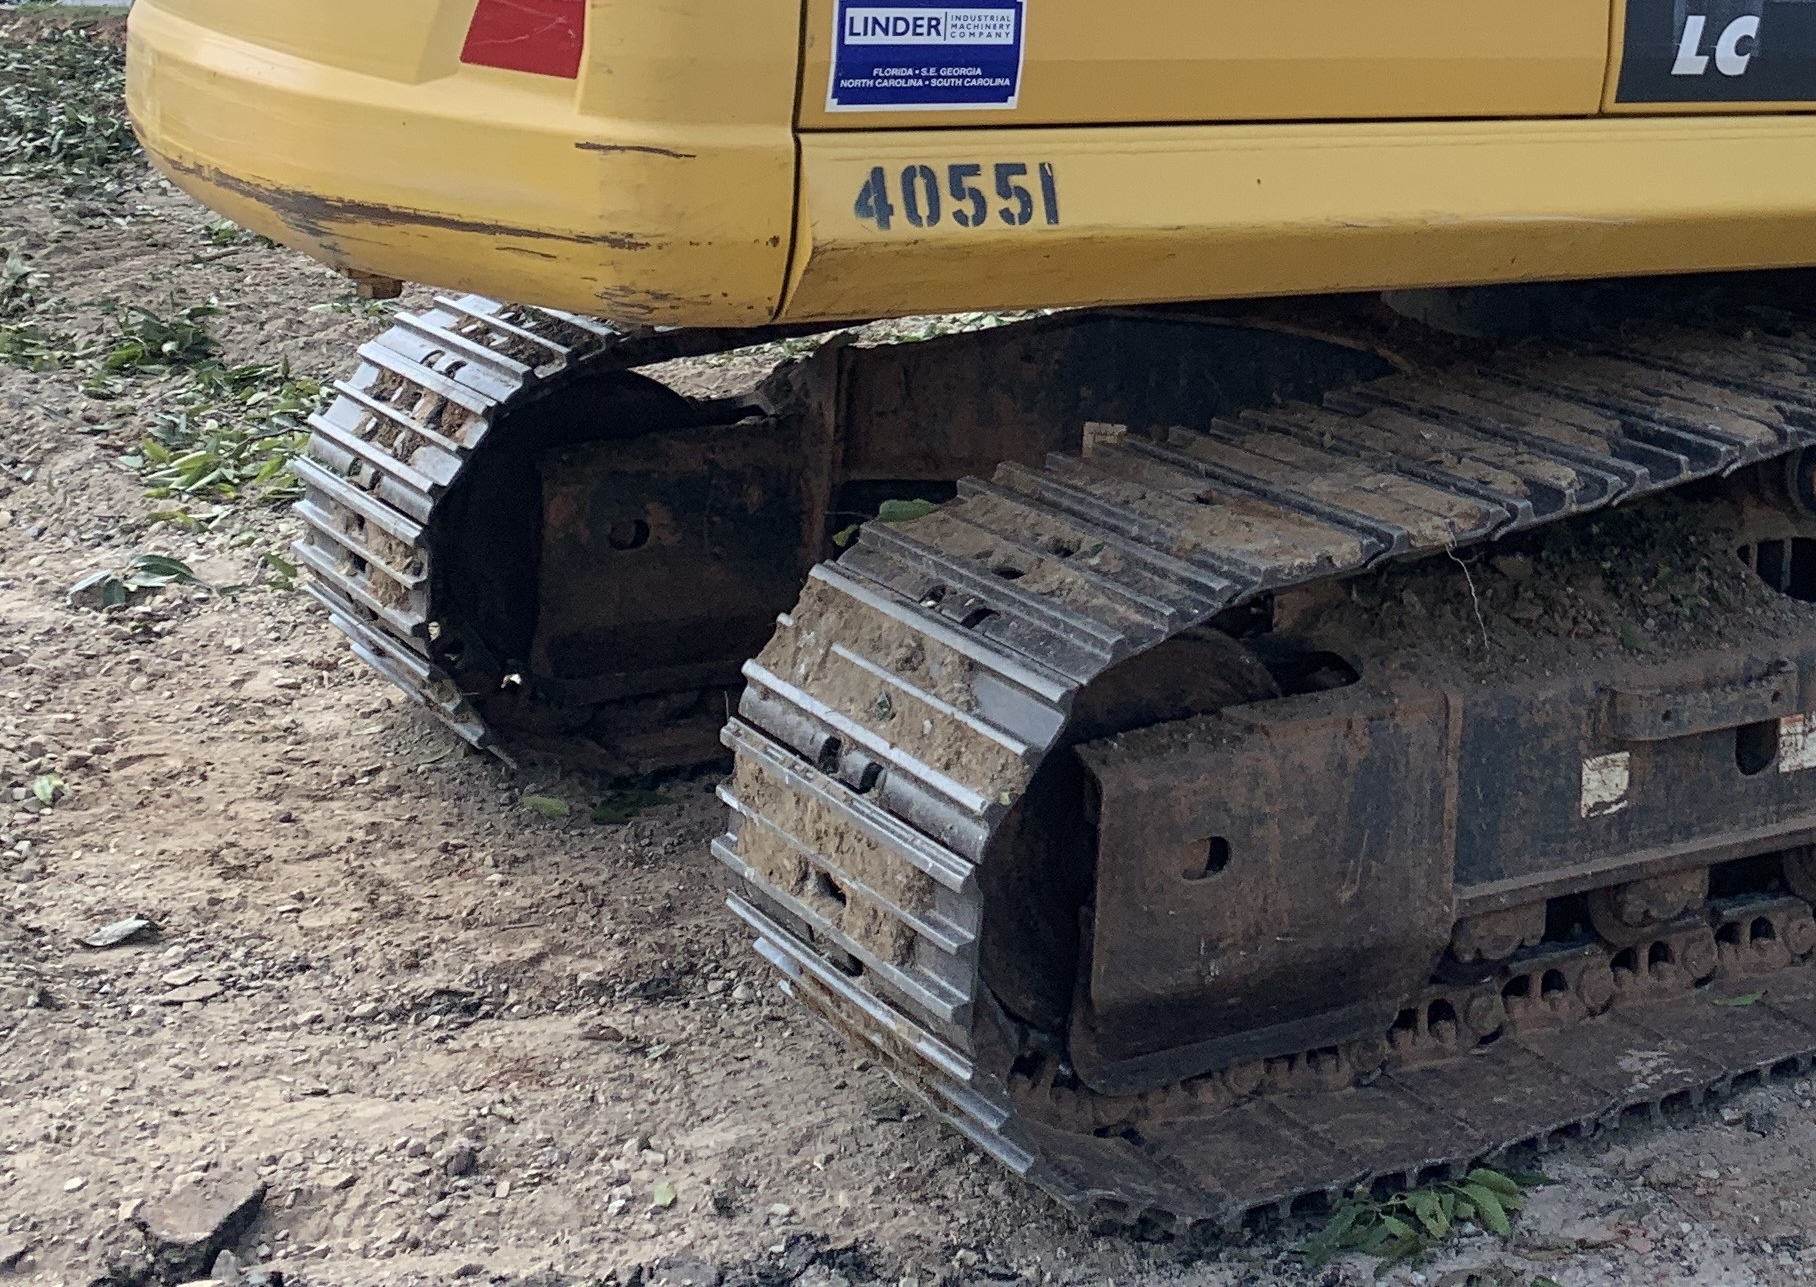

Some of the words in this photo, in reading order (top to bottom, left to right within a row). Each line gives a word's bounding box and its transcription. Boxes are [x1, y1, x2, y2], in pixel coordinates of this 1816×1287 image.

[950, 14, 1011, 22] INDUSTRIAL
[848, 16, 942, 37] LINDER
[1670, 15, 1761, 76] LC
[873, 67, 913, 76] FLORIDA
[920, 67, 938, 76] S.E.
[939, 67, 982, 76] GEORGIA
[840, 79, 874, 88] NORTH
[875, 78, 923, 88] CAROLINA
[930, 78, 962, 87] SOUTH
[963, 78, 1011, 87] CAROLINA
[854, 162, 1059, 230] 40551
